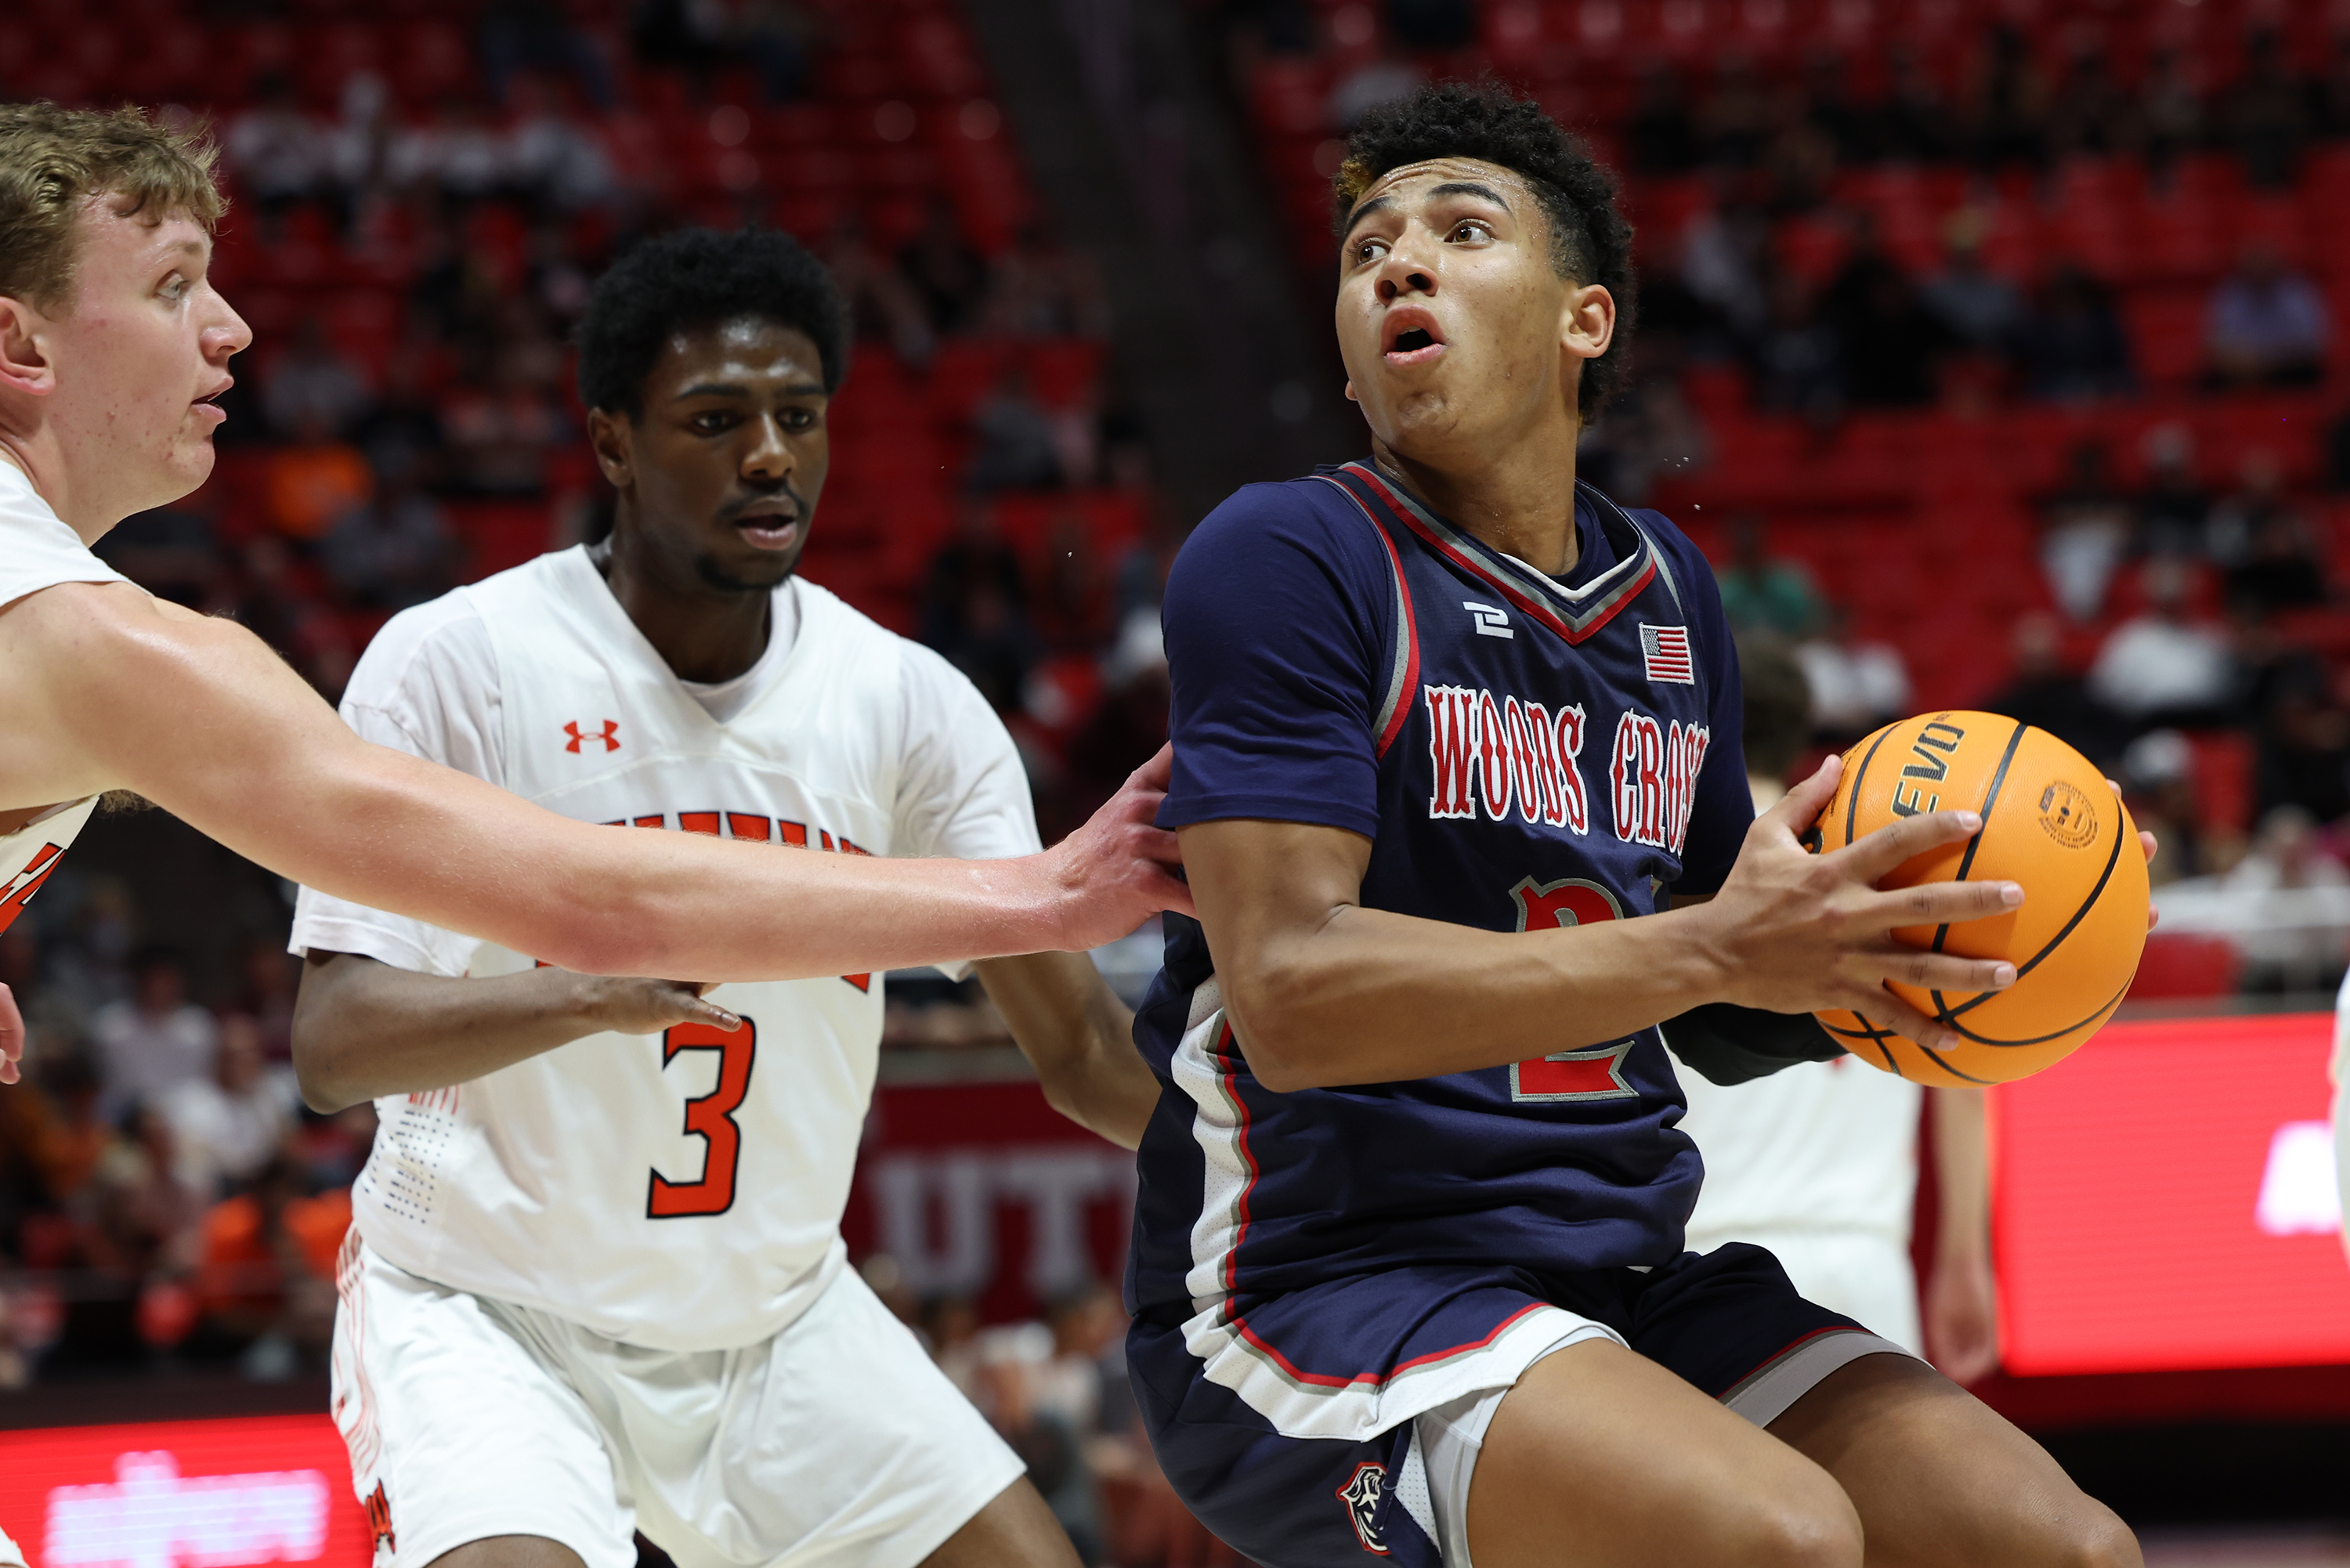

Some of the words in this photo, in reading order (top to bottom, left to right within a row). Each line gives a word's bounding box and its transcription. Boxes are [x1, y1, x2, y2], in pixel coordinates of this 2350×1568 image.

[1424, 684, 1589, 836] WOODS
[1891, 722, 1966, 819] EVO
[646, 1015, 756, 1219] 3
[873, 1150, 1141, 1294] UT
